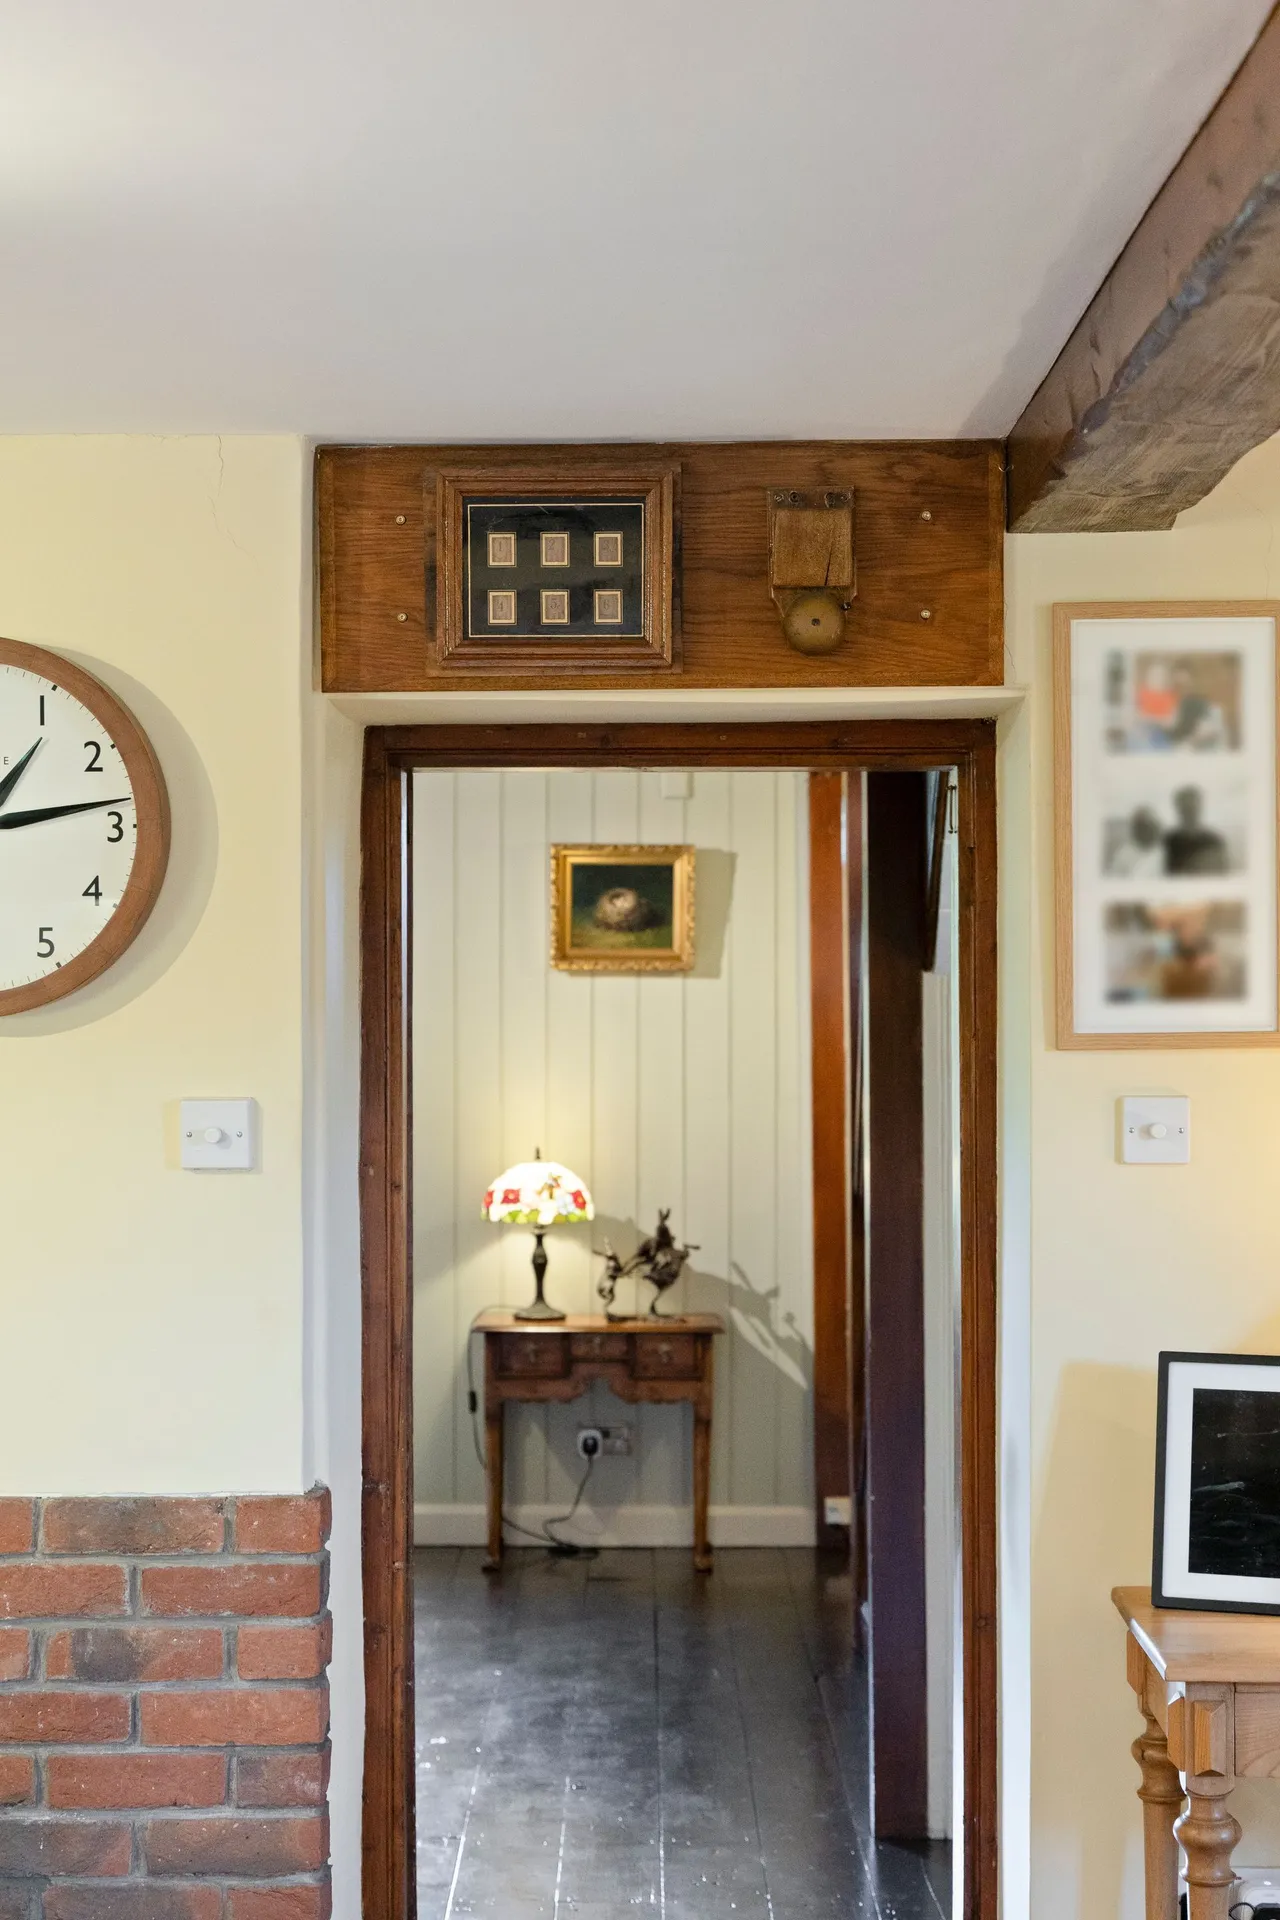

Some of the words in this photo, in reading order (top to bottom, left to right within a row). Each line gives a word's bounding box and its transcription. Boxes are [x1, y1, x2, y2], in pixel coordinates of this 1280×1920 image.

[547, 539, 556, 551] 2
[39, 695, 45, 726] 1
[83, 741, 103, 772] 2
[107, 811, 124, 843] 3
[82, 875, 102, 906] 4
[36, 927, 55, 959] 5
